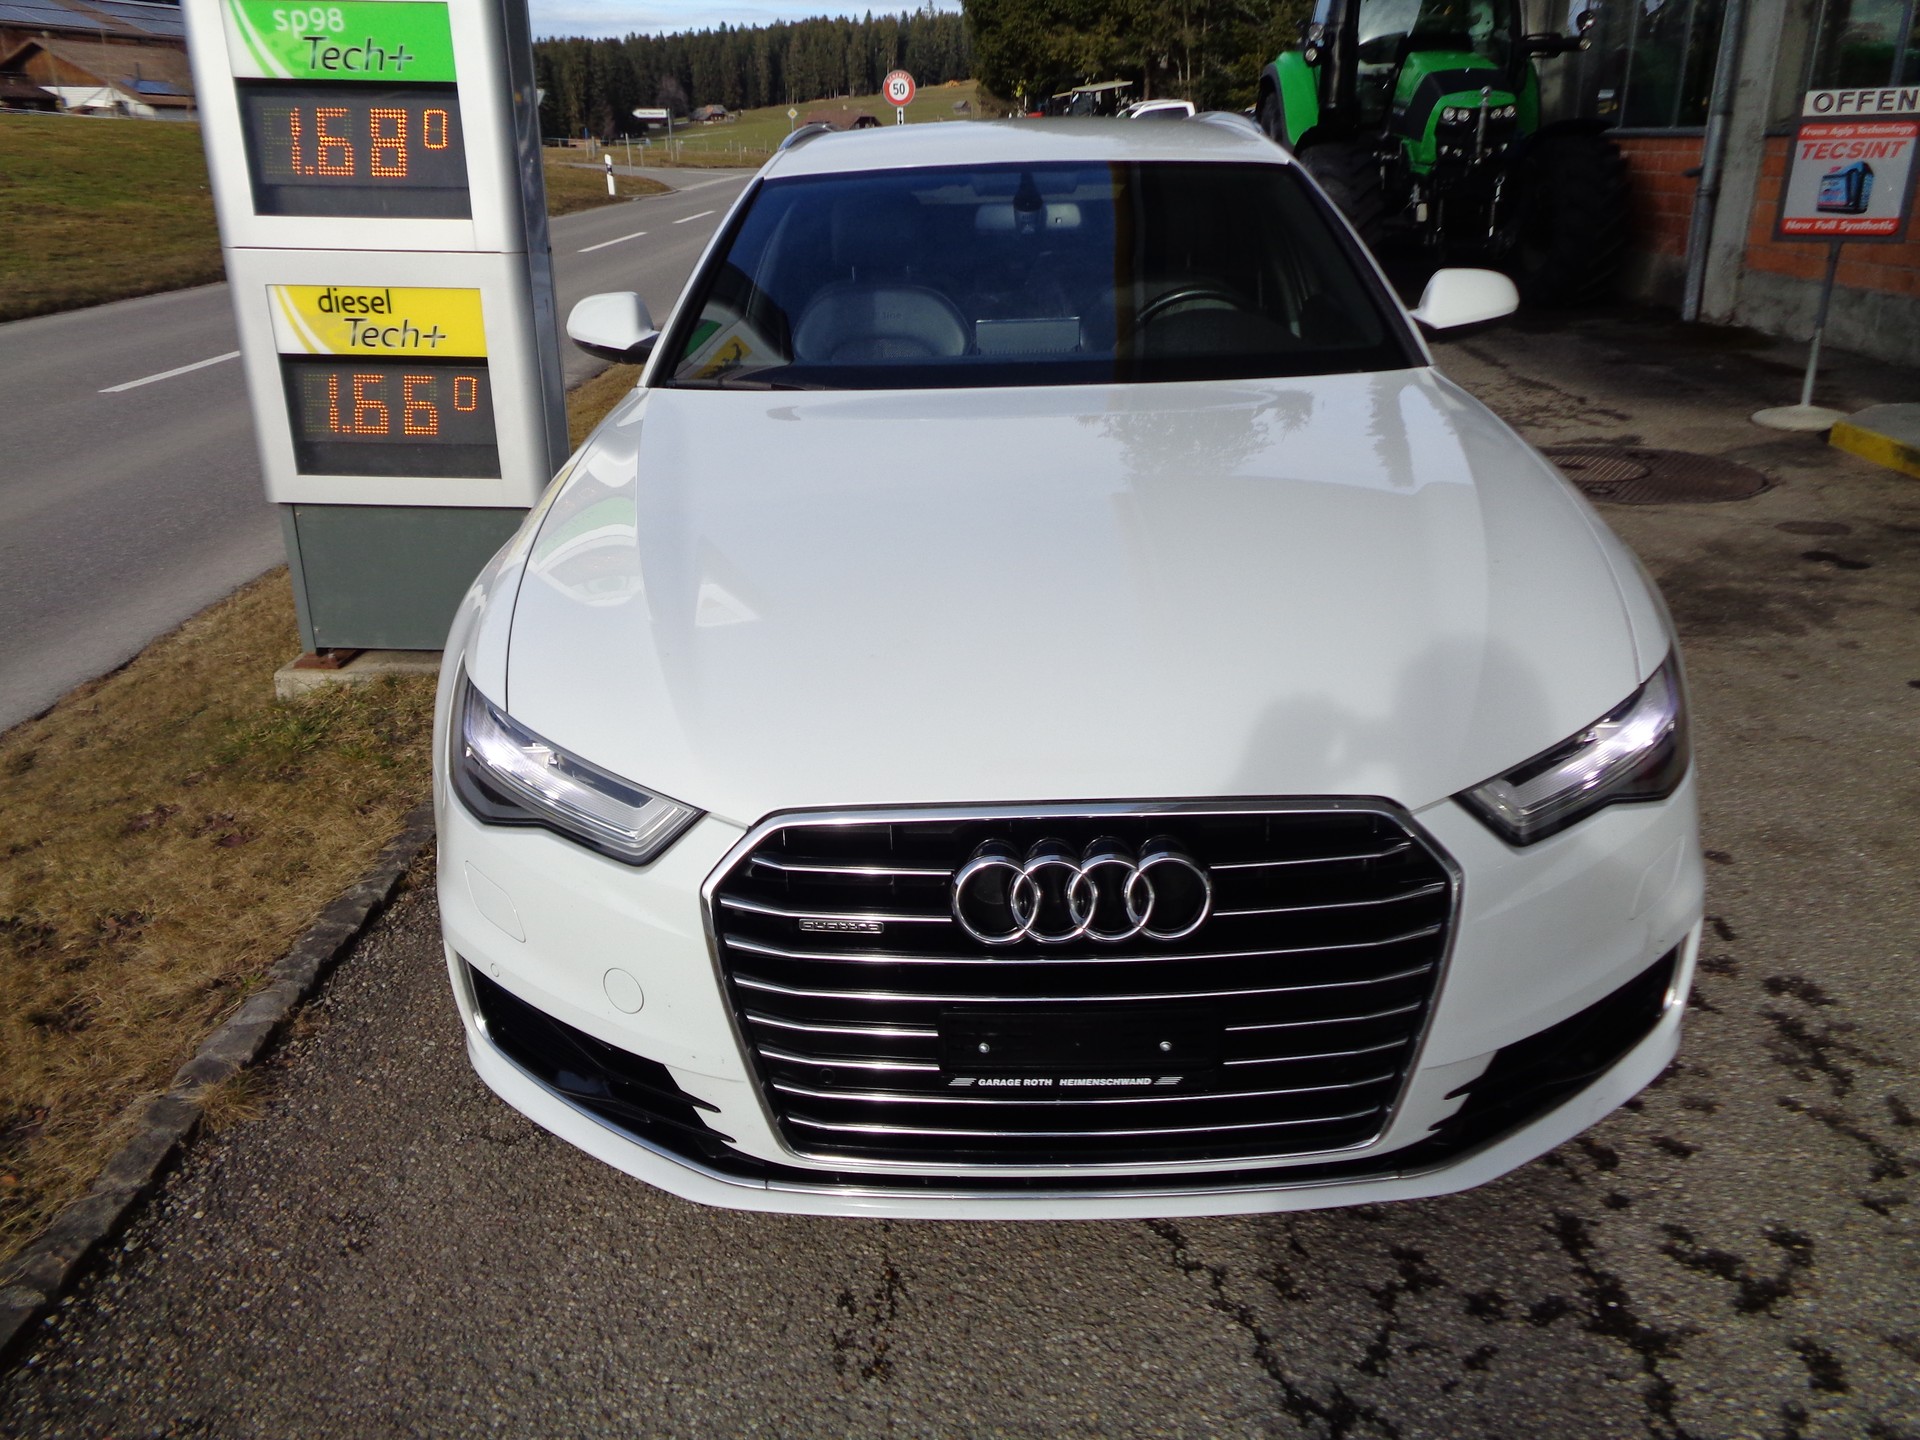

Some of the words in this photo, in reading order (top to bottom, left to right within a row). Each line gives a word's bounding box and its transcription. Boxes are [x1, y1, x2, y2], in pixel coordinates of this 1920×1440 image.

[272, 7, 345, 38] sp98
[302, 35, 415, 72] Tech+
[893, 83, 906, 96] 50
[1813, 90, 1919, 113] OFFEN
[1856, 125, 1916, 136] Technology
[1800, 141, 1908, 161] TECSINT
[1839, 219, 1895, 232] Synthetic
[317, 287, 393, 315] diesel
[343, 318, 447, 349] Tech+
[977, 1077, 1021, 1088] GARAGE
[1023, 1077, 1053, 1088] ROTH
[1059, 1076, 1152, 1088] HEIMENSCHWAND
